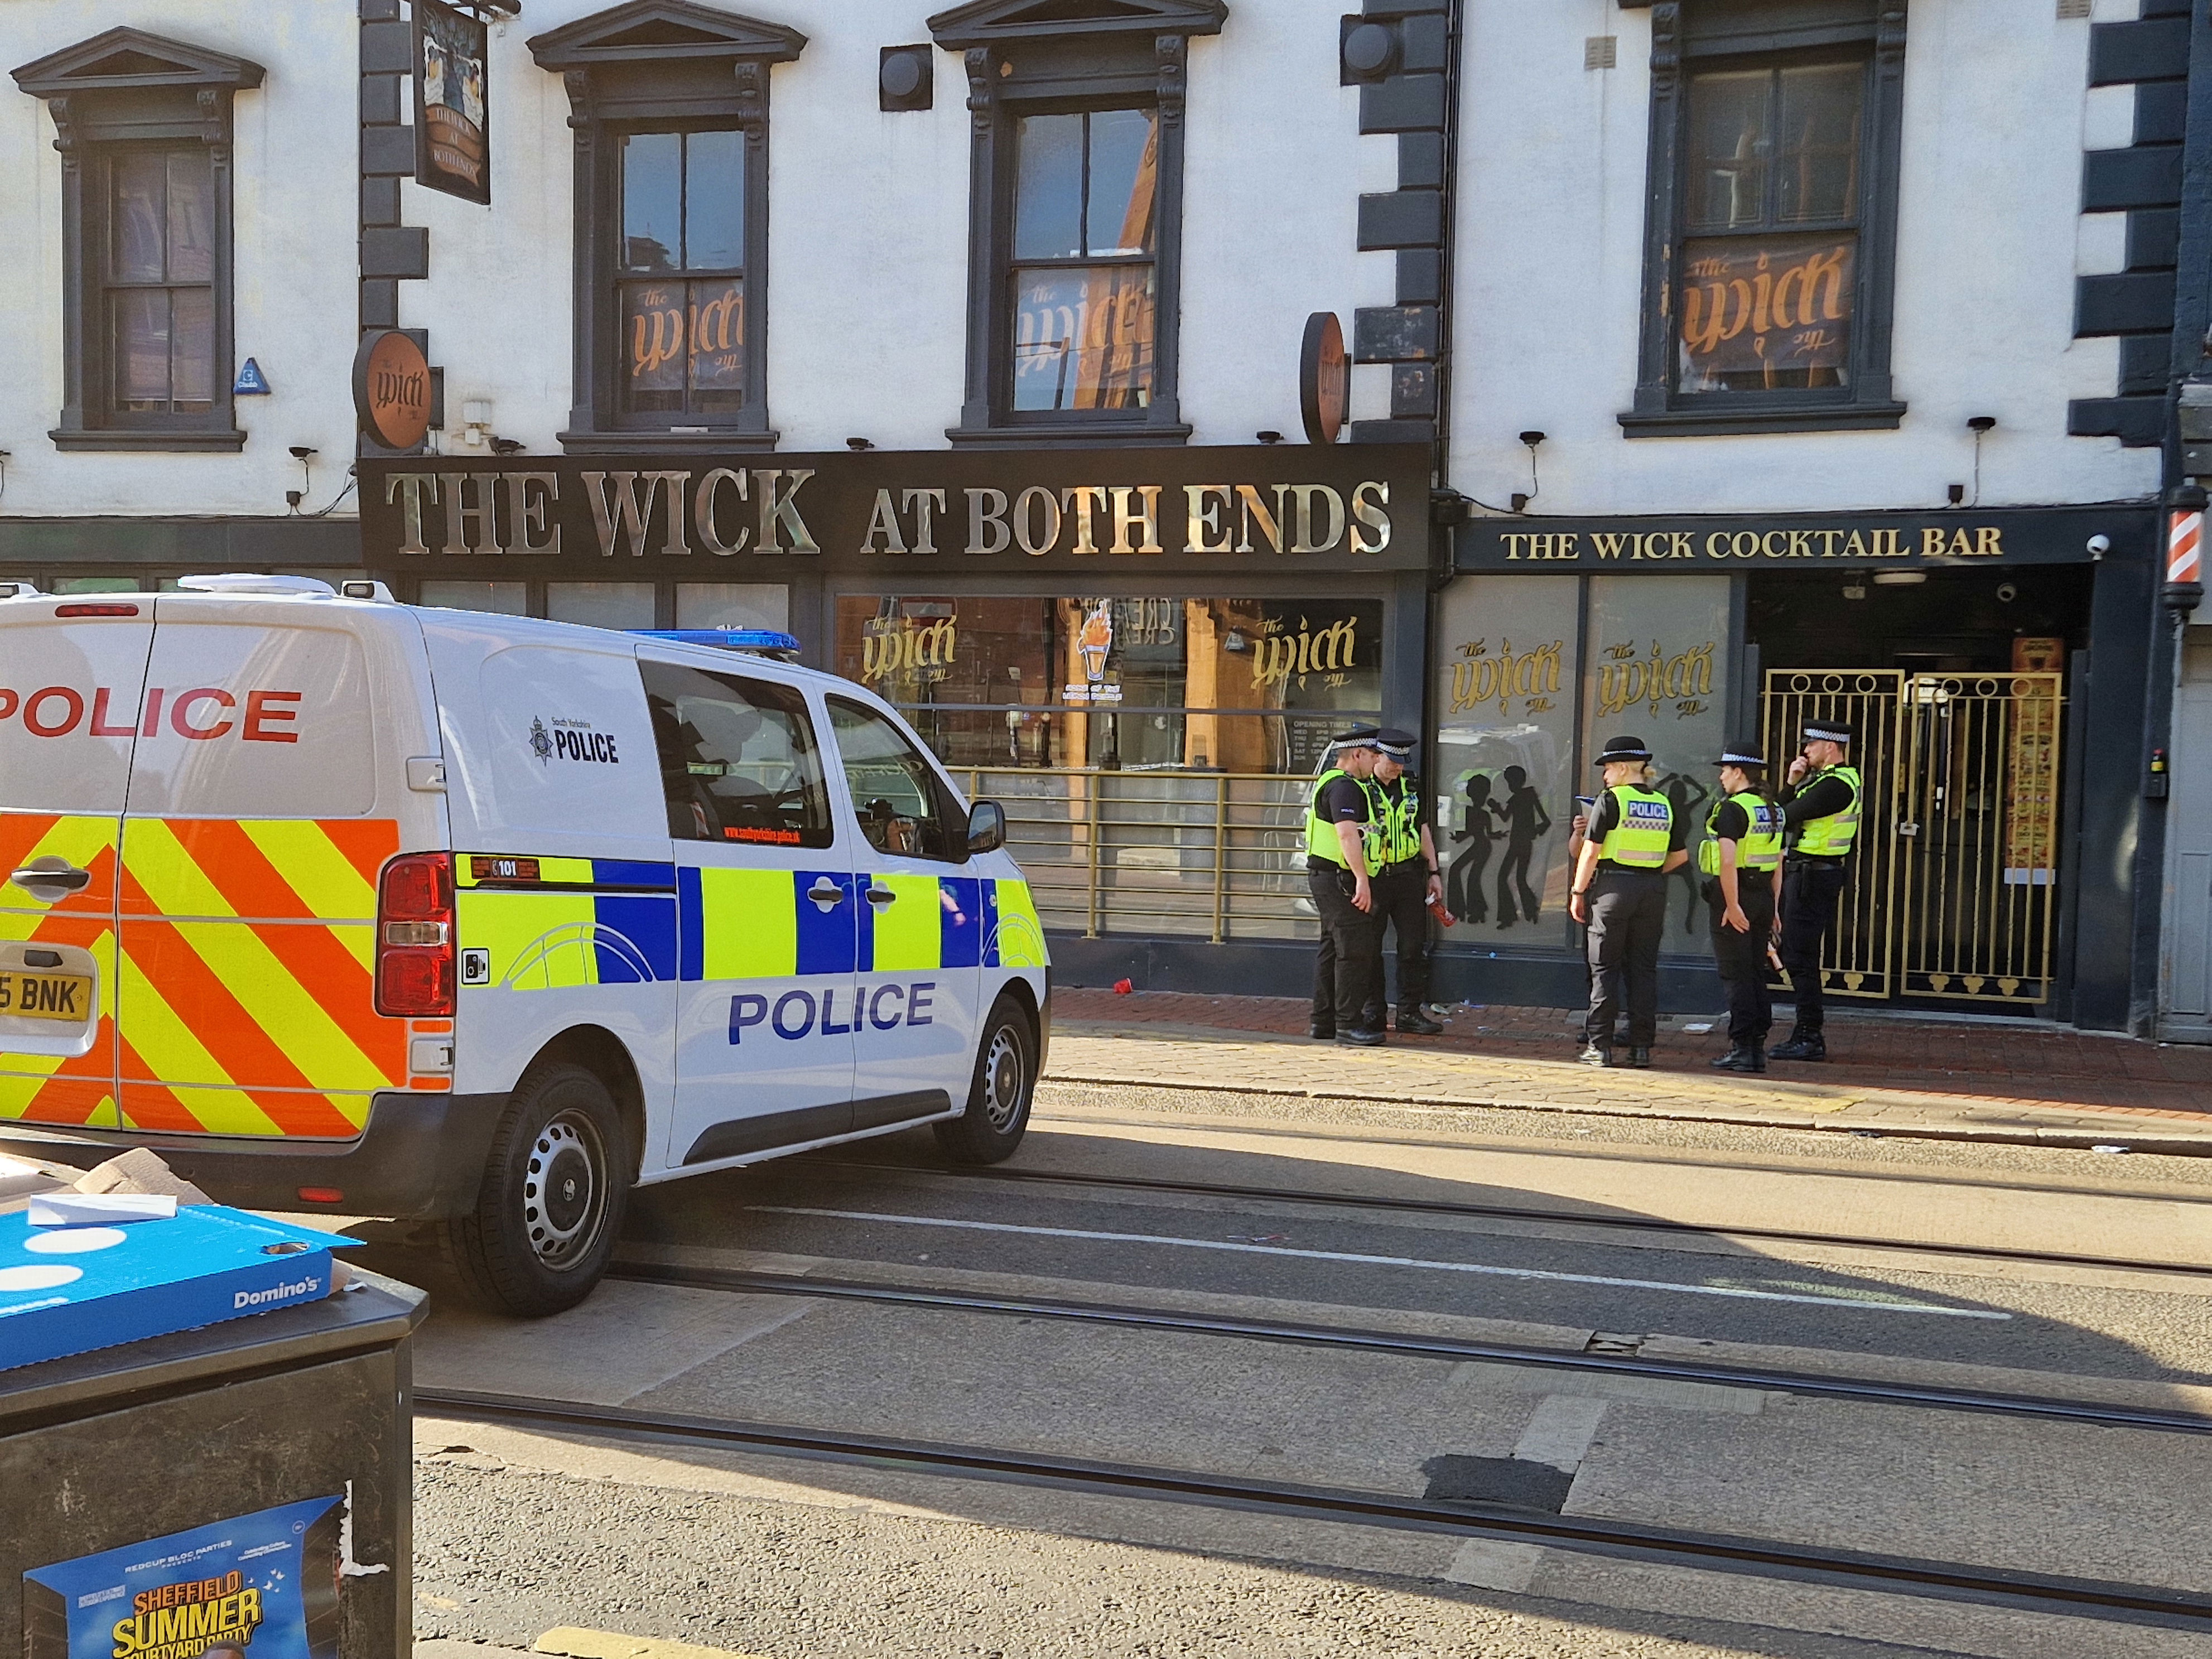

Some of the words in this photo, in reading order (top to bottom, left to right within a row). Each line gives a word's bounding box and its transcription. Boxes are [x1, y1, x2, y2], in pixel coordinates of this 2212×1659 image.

[449, 131, 458, 145] AT
[638, 288, 668, 307] the
[385, 472, 560, 554] THE
[581, 467, 821, 556] WICK
[860, 488, 946, 554] AT
[963, 485, 1163, 556] BOTH
[1182, 481, 1391, 554] ENDS
[1500, 533, 1579, 560] THE
[1589, 532, 1696, 560] WICK
[1705, 528, 1910, 558] COCKTAIL
[1920, 527, 2004, 557] BAR
[865, 613, 891, 630] the
[1256, 615, 1284, 633] the
[1456, 638, 1486, 657] the
[1603, 640, 1635, 659] the
[555, 730, 619, 764] POLICE
[1628, 802, 1668, 819] POLICE
[499, 860, 517, 876] 101
[20, 978, 78, 1014] BNK
[729, 982, 936, 1045] POLICE
[234, 1276, 318, 1309] Domino's
[124, 1557, 166, 1574] REDCUP
[168, 1551, 194, 1562] BLOC
[196, 1540, 233, 1556] PARTIES
[134, 1571, 242, 1616] SHEFFIELD
[113, 1588, 259, 1658] SUMMER
[124, 1638, 205, 1659] OURTYARD
